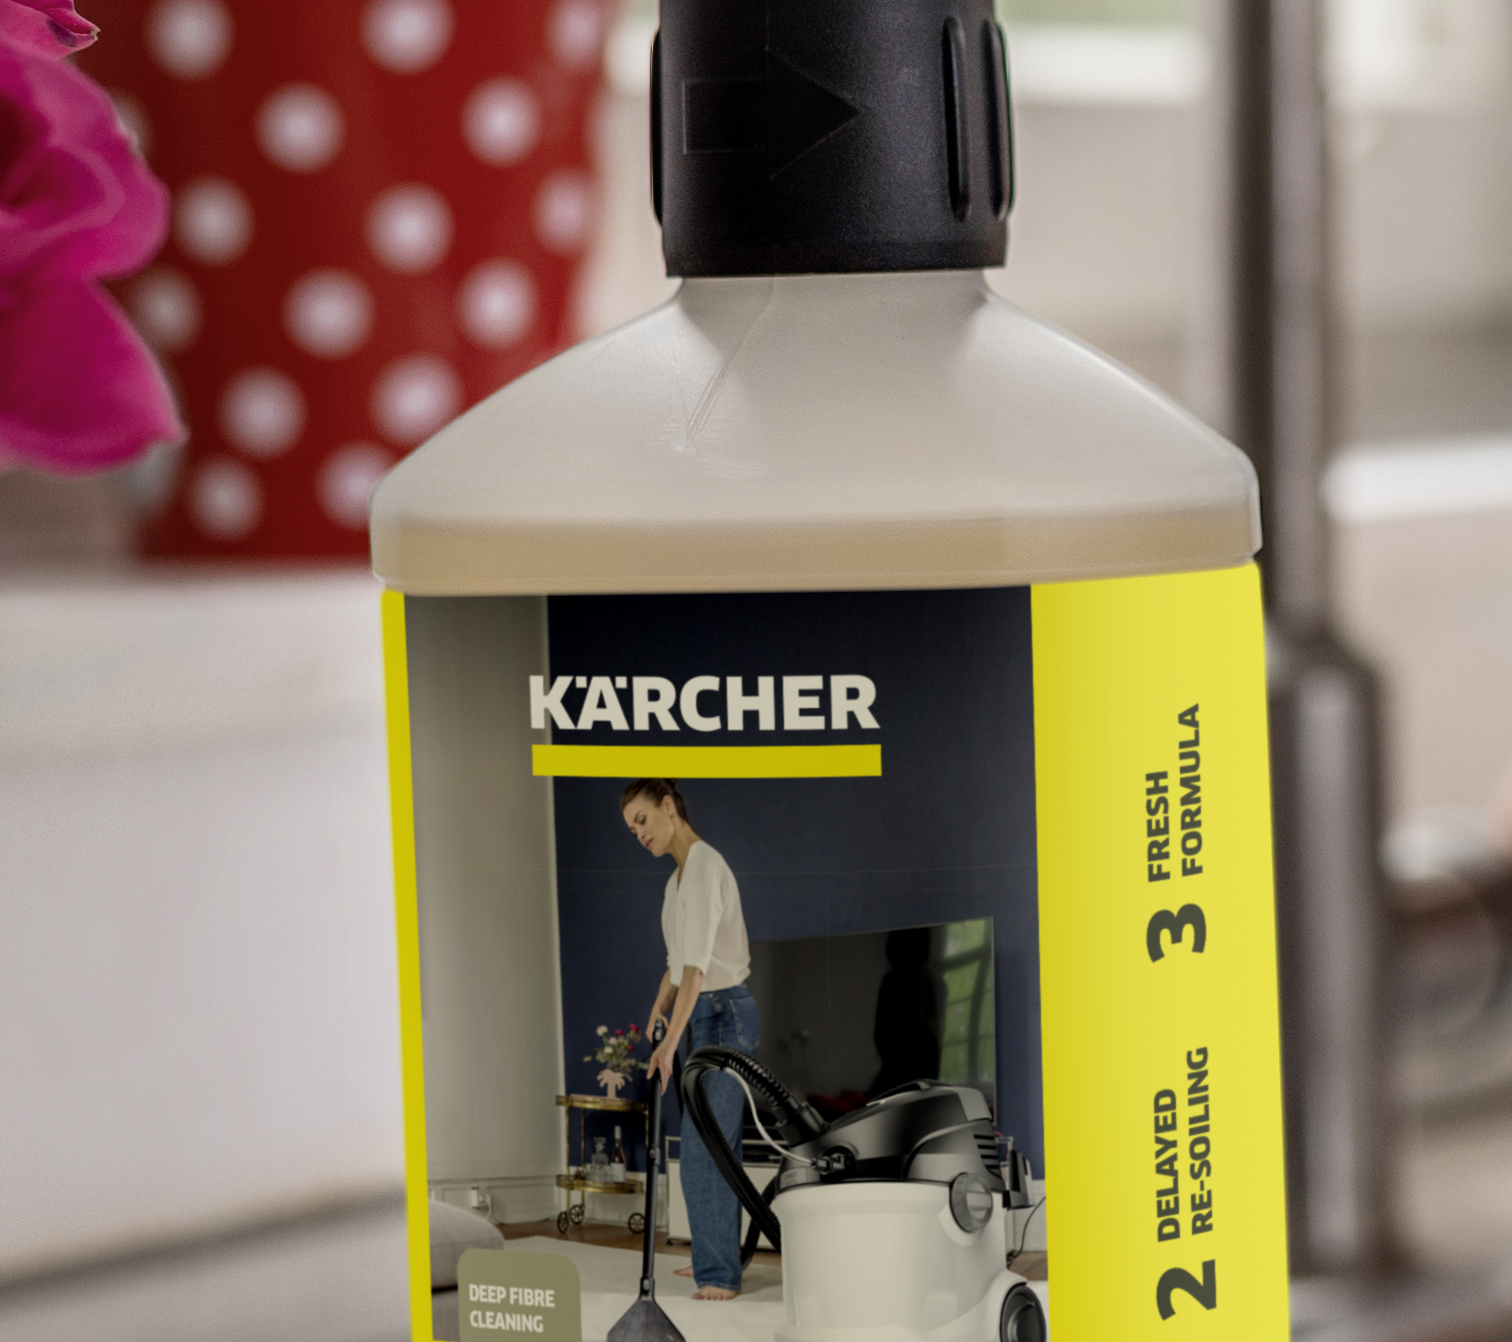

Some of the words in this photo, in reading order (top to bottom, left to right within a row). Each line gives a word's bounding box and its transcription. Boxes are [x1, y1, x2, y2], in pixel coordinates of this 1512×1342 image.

[529, 674, 880, 732] KÄRCHER
[1177, 703, 1204, 877] FORMULA
[1145, 770, 1171, 883] FRESH
[1145, 902, 1207, 964] 3
[1153, 1088, 1181, 1243] DELAYED
[1186, 1046, 1214, 1236] RE-SOILING
[468, 1283, 506, 1304] DEEP
[509, 1286, 556, 1308] FIBRE
[1155, 1258, 1217, 1321] 2
[469, 1310, 544, 1333] CLEANING
